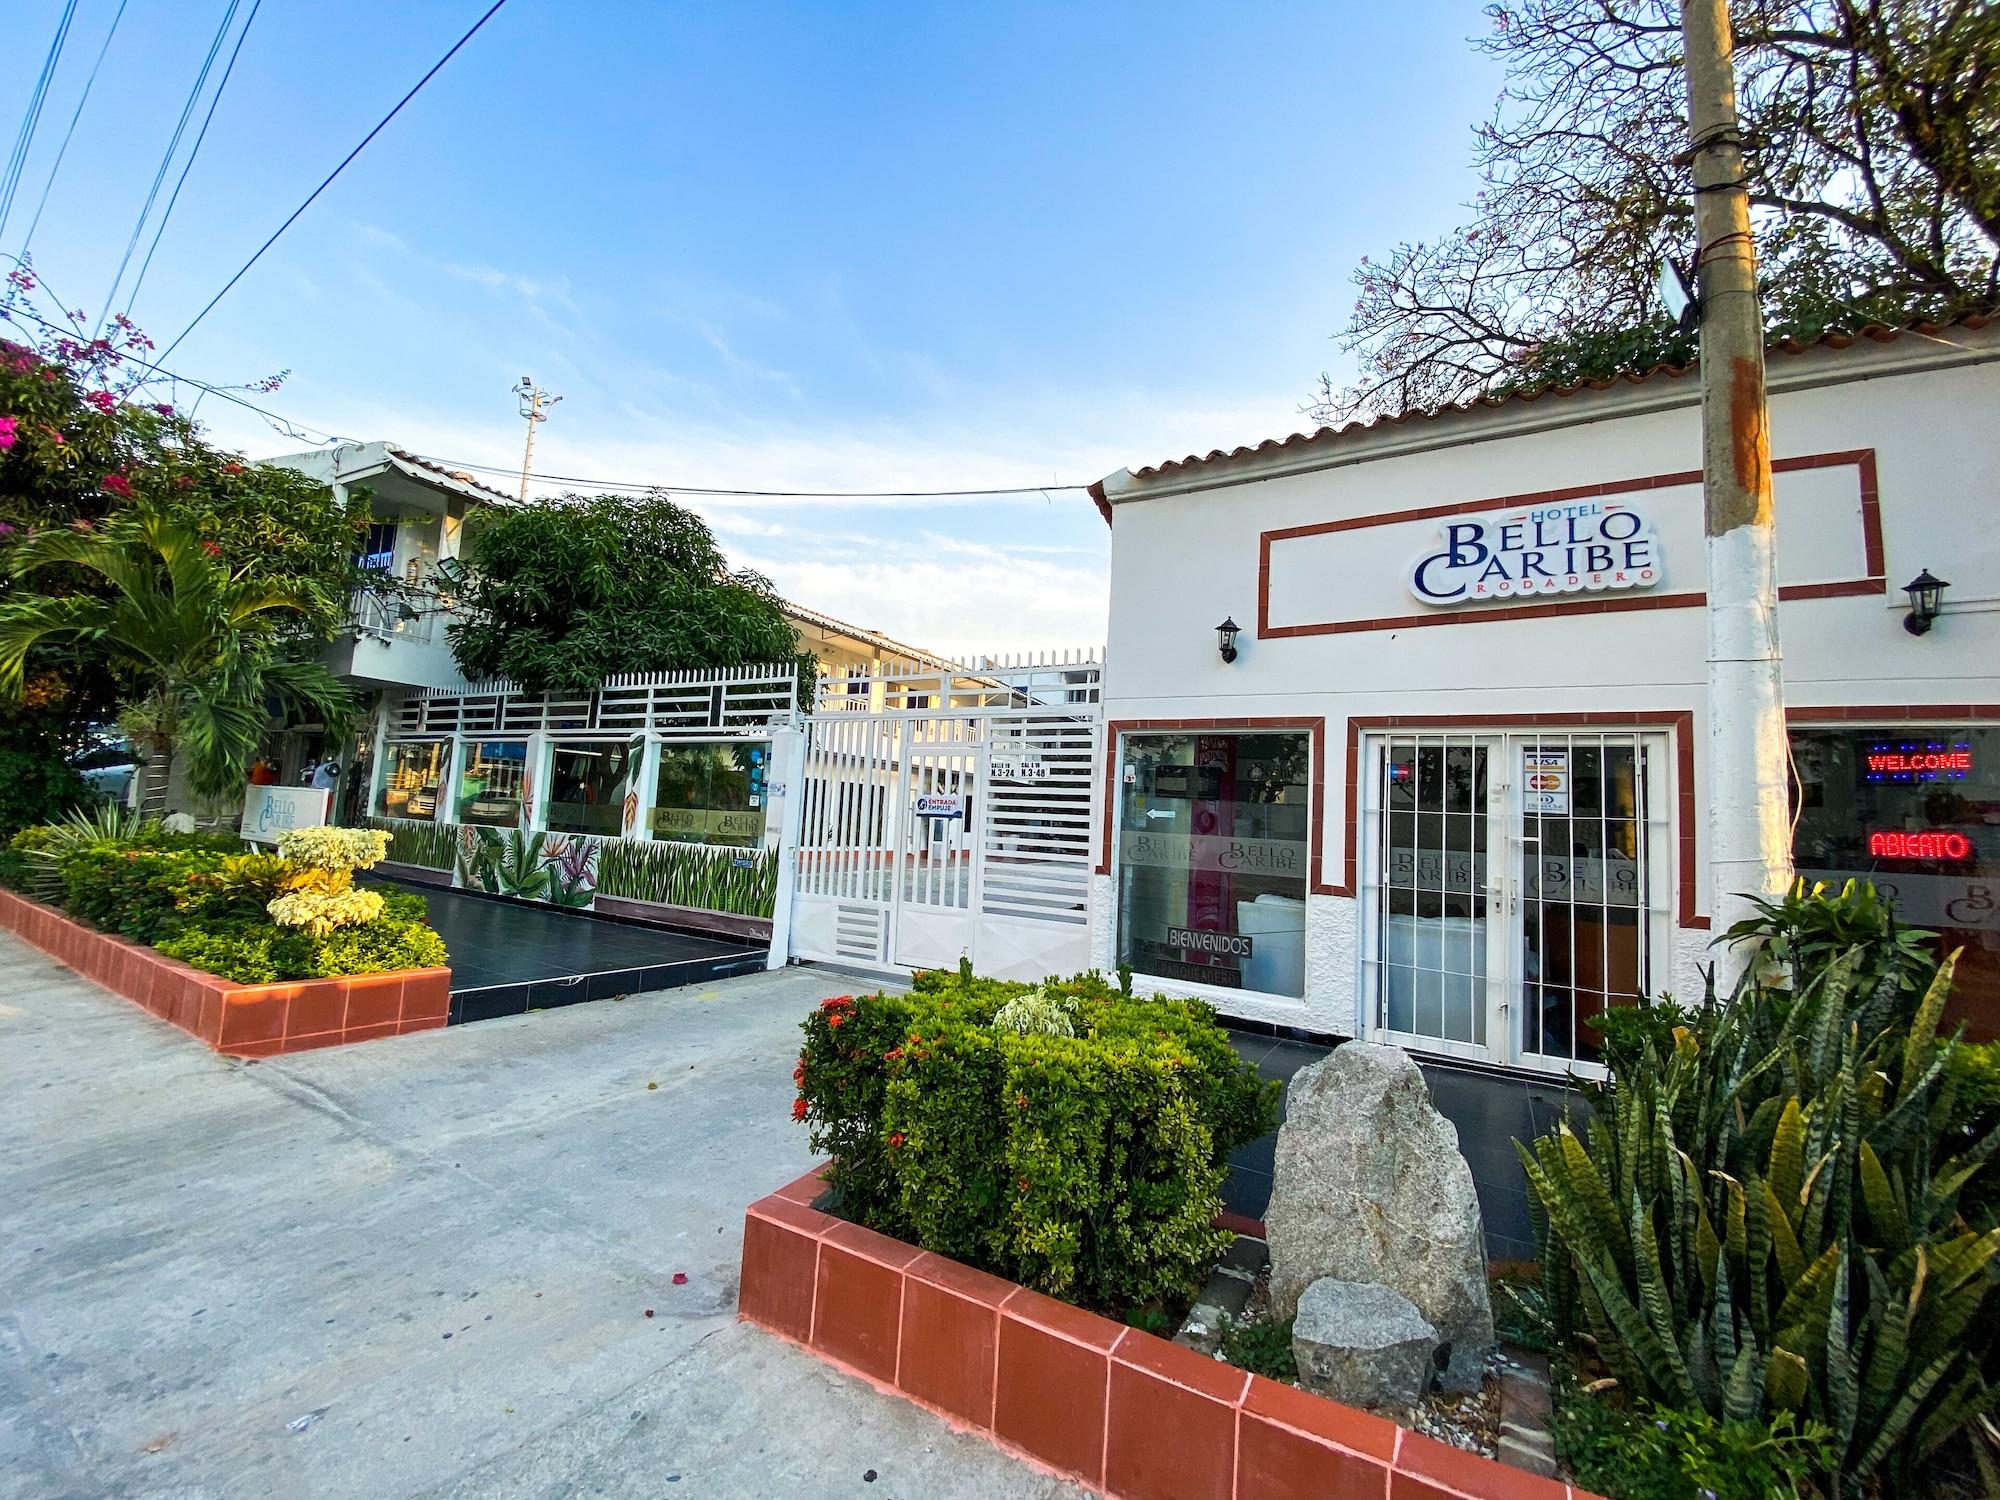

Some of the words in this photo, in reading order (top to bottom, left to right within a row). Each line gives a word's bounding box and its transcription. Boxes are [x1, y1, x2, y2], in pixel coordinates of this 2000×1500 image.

[1531, 503, 1601, 522] HOTEL
[1446, 511, 1641, 569] BELLO
[1414, 540, 1651, 598] CARIBE
[1476, 569, 1653, 593] RODADERO
[1868, 753, 1971, 770] WELCOME
[265, 795, 296, 818] BELLO
[663, 811, 694, 822] BELLO
[724, 815, 759, 827] BELLO
[1230, 842, 1295, 859] BELLO
[1871, 833, 1967, 858] ABIERTO
[1218, 851, 1297, 870] CARIBE
[1544, 861, 1635, 883] BEO
[1529, 873, 1639, 894] CARBE
[1169, 929, 1249, 956] BIENVENIDOS
[1161, 962, 1236, 986] PARQUEADERO
